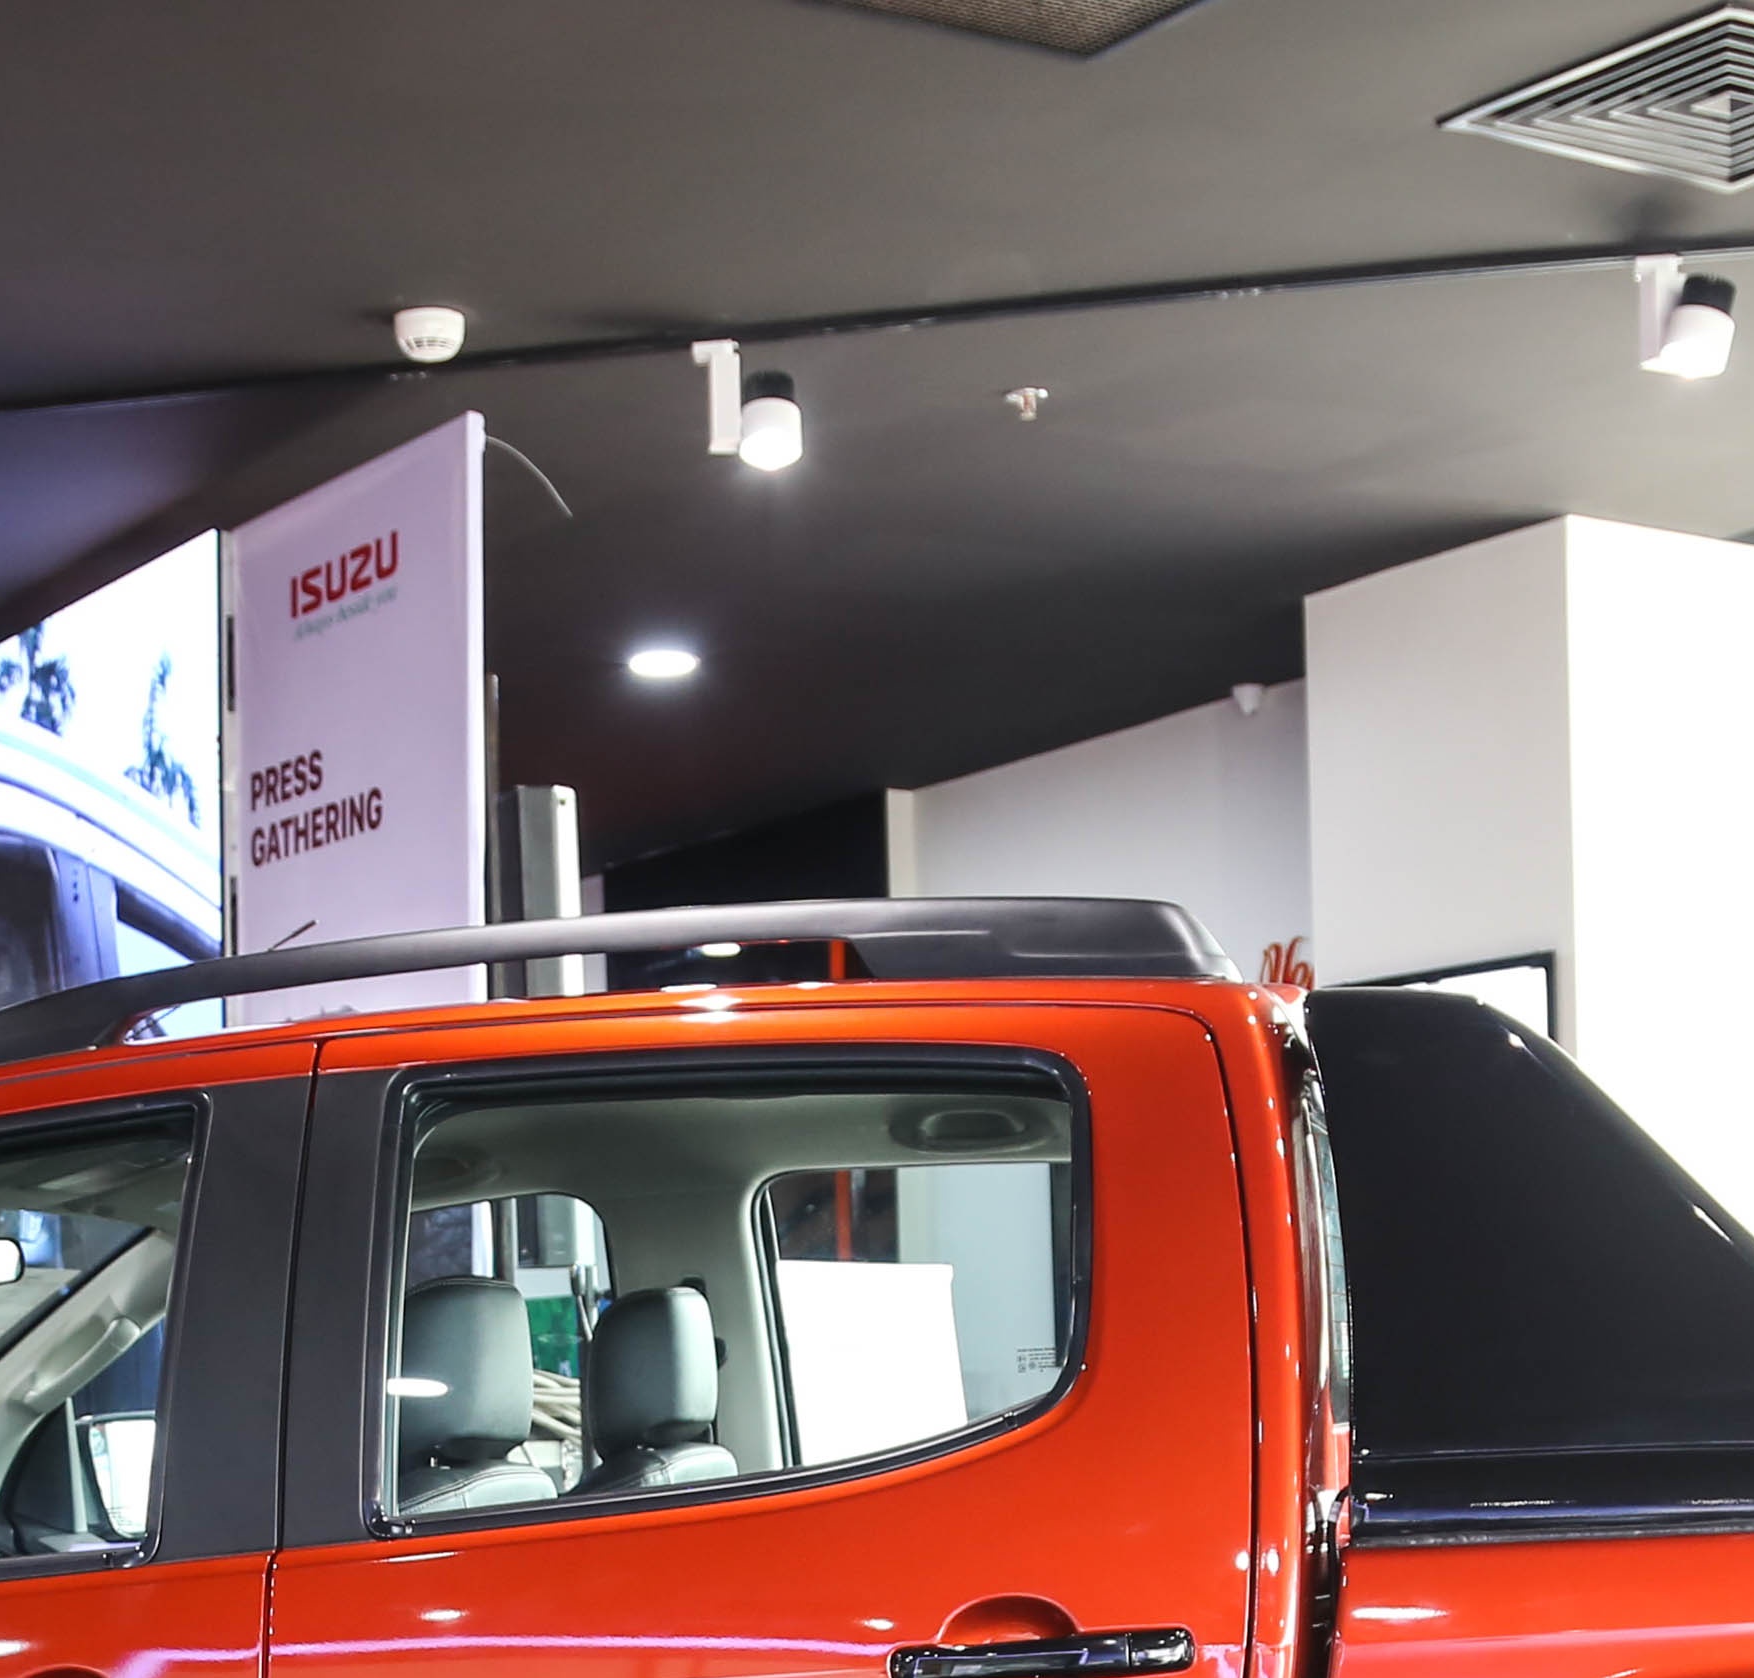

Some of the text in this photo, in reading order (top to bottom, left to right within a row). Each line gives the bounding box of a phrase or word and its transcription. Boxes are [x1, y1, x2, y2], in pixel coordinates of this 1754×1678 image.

[290, 529, 399, 620] ISUZU
[250, 748, 323, 812] PRESS
[250, 786, 383, 868] GATHERING
